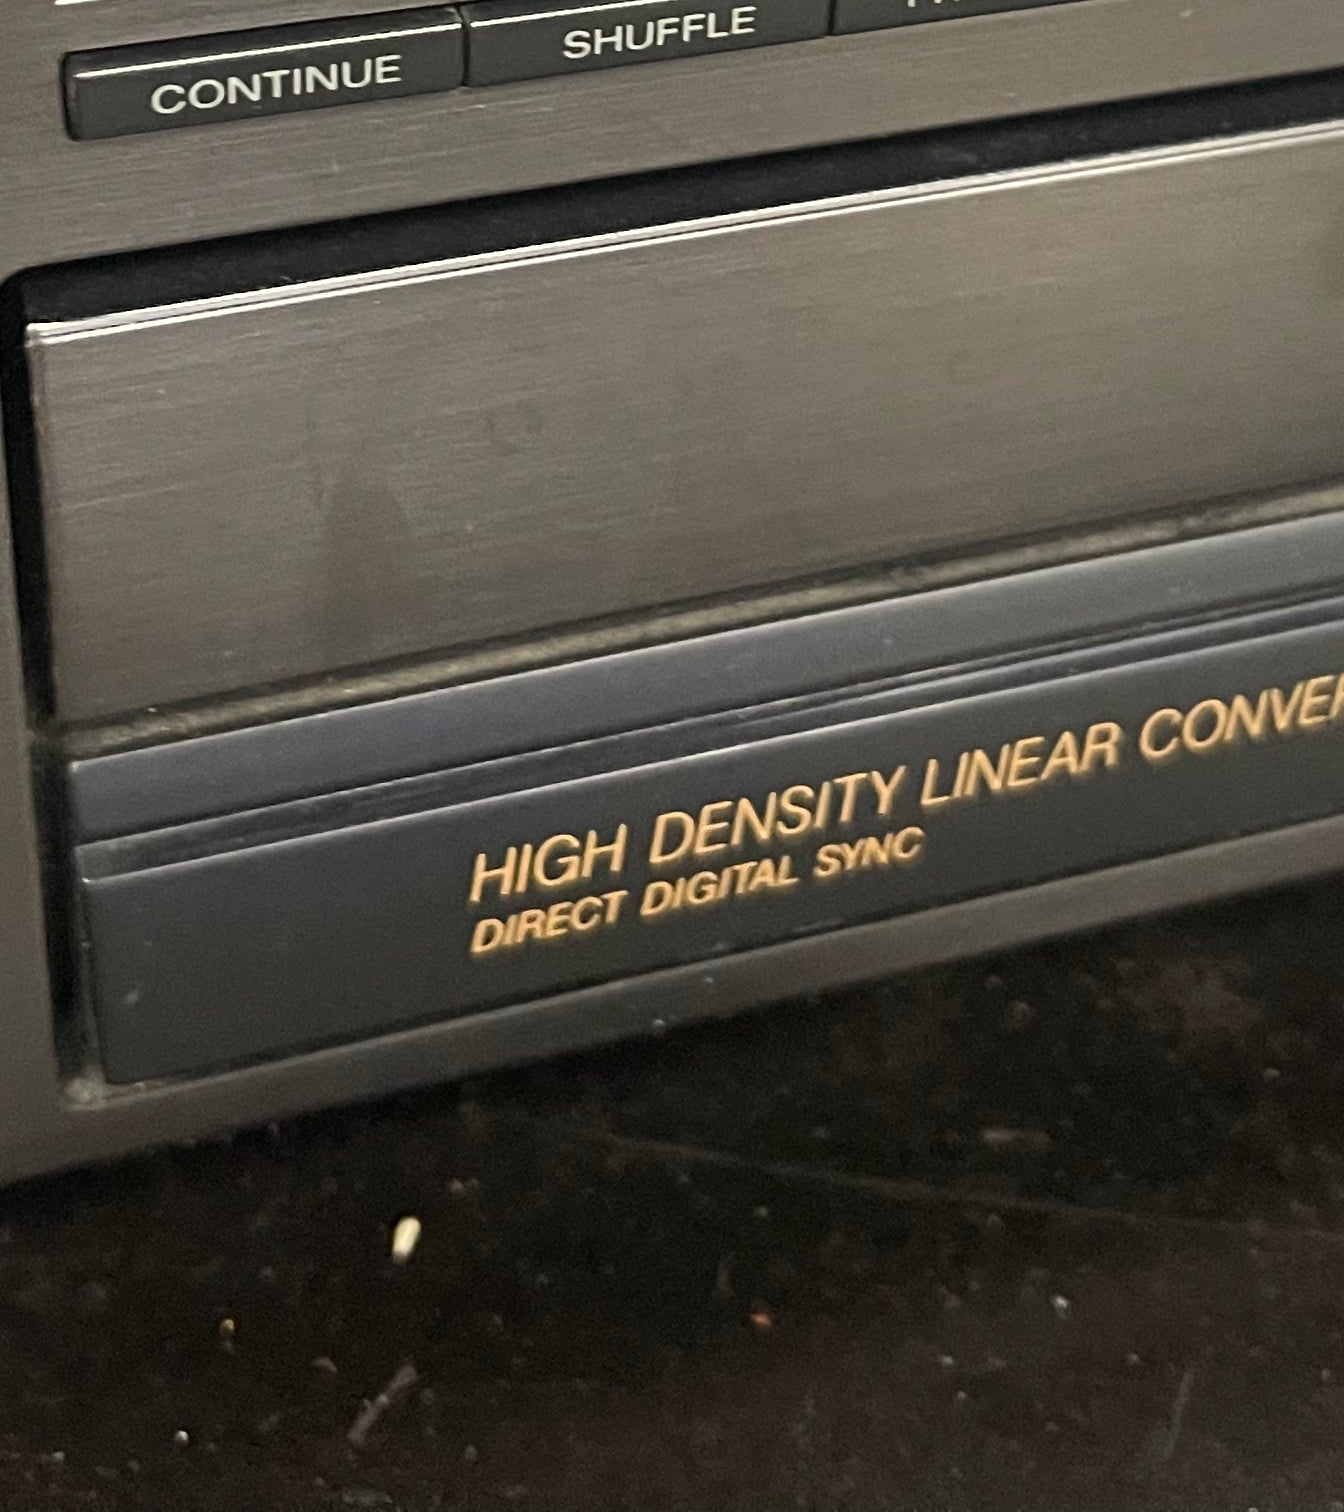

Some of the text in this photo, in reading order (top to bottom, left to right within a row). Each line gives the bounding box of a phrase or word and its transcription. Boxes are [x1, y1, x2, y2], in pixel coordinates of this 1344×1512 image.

[561, 5, 758, 60] SHUFFLE
[149, 53, 403, 115] CONTINUE
[469, 823, 629, 903] HIGH
[649, 764, 907, 865] DENSITY
[920, 721, 1124, 808] LINEAR
[470, 826, 925, 954] DIRECT DIGITAL SYNC
